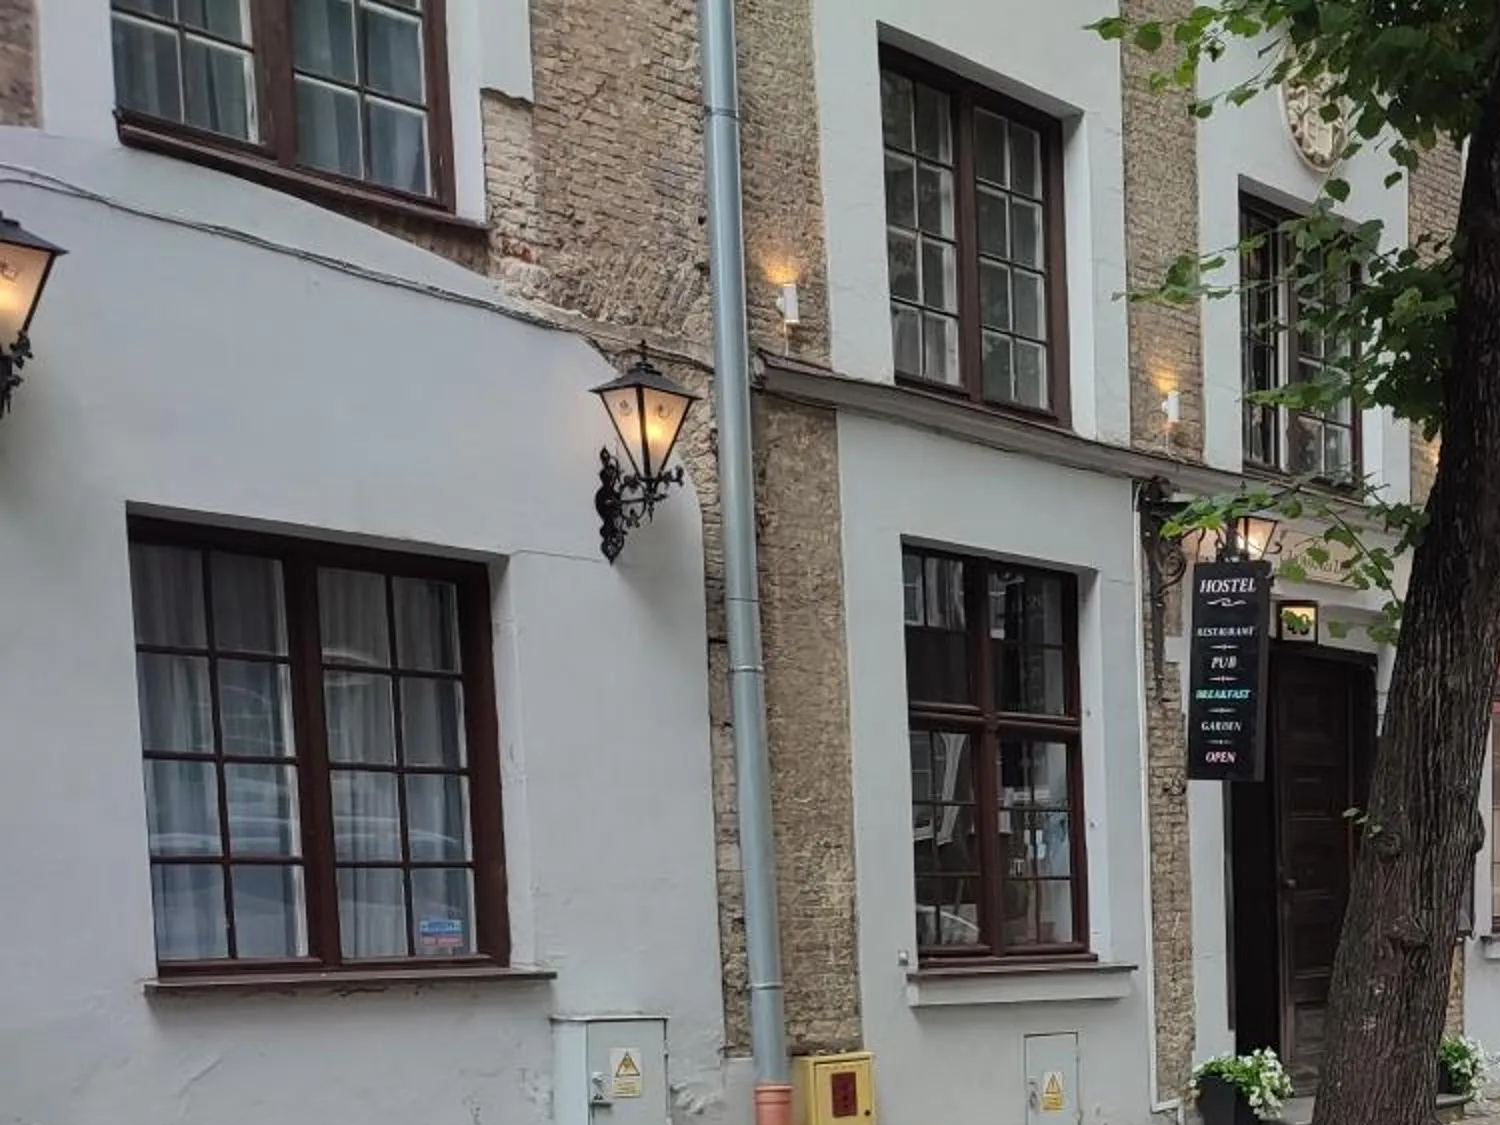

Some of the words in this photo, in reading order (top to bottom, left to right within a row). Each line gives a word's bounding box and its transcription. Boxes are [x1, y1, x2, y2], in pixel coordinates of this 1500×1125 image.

[1199, 577, 1256, 593] HOSTEL
[1197, 626, 1256, 637] RESTAURANT
[1211, 655, 1238, 669] PUB
[1195, 689, 1251, 699] BREAKFAST
[1201, 721, 1242, 732] GARDEN
[1205, 751, 1237, 763] OPEN
